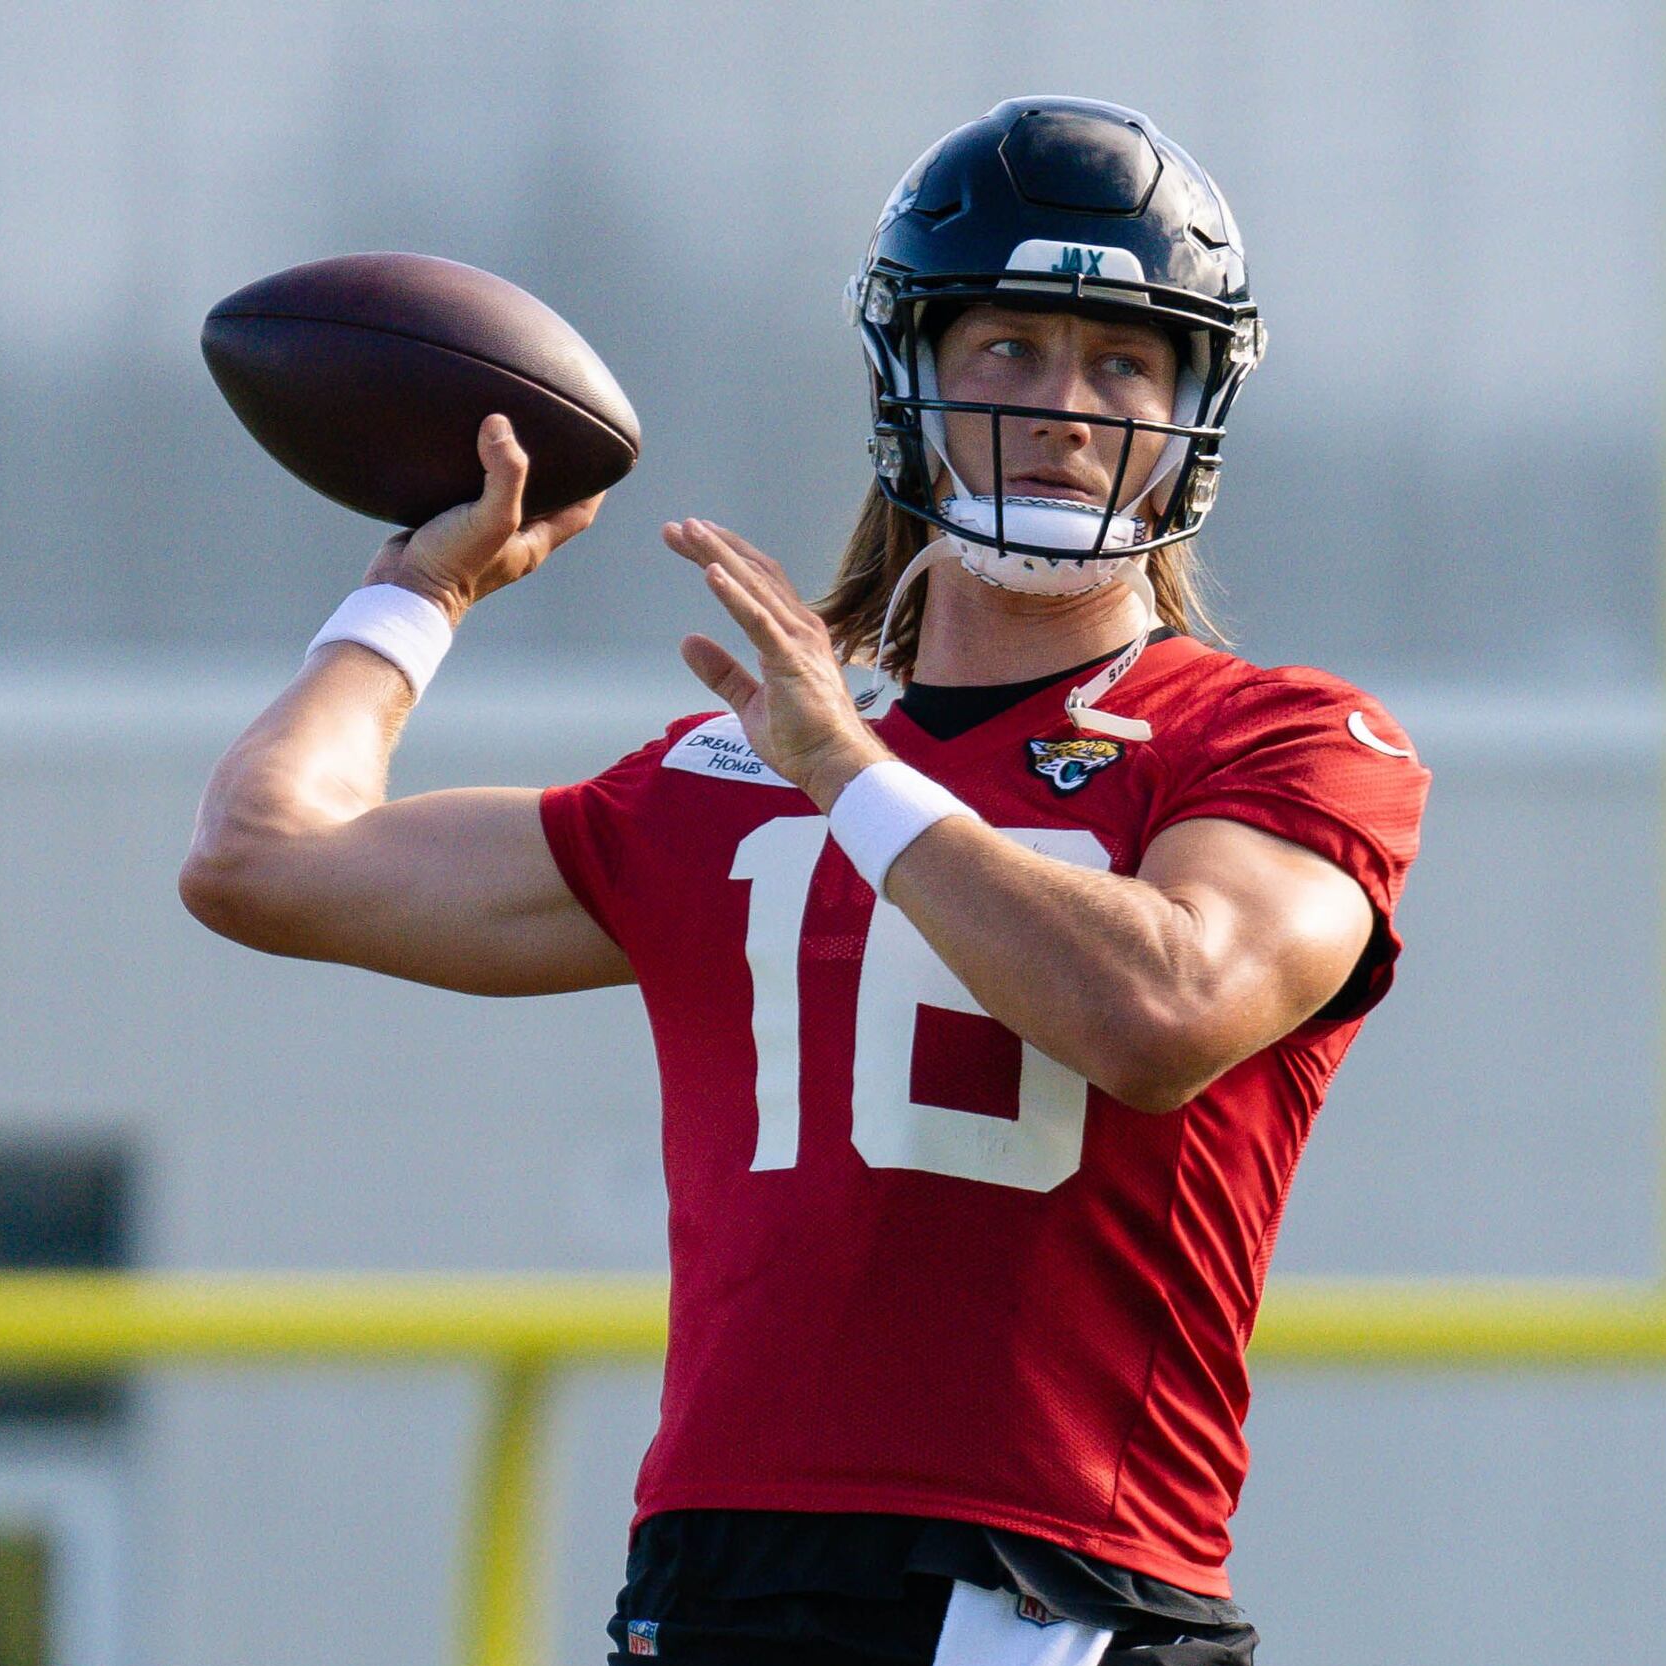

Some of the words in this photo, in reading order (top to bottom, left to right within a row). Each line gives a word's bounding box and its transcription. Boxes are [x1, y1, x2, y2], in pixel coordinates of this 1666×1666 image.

[1051, 246, 1105, 277] JAX
[686, 734, 744, 753] DREAM
[707, 753, 765, 775] HOMES
[728, 814, 1111, 1193] 16
